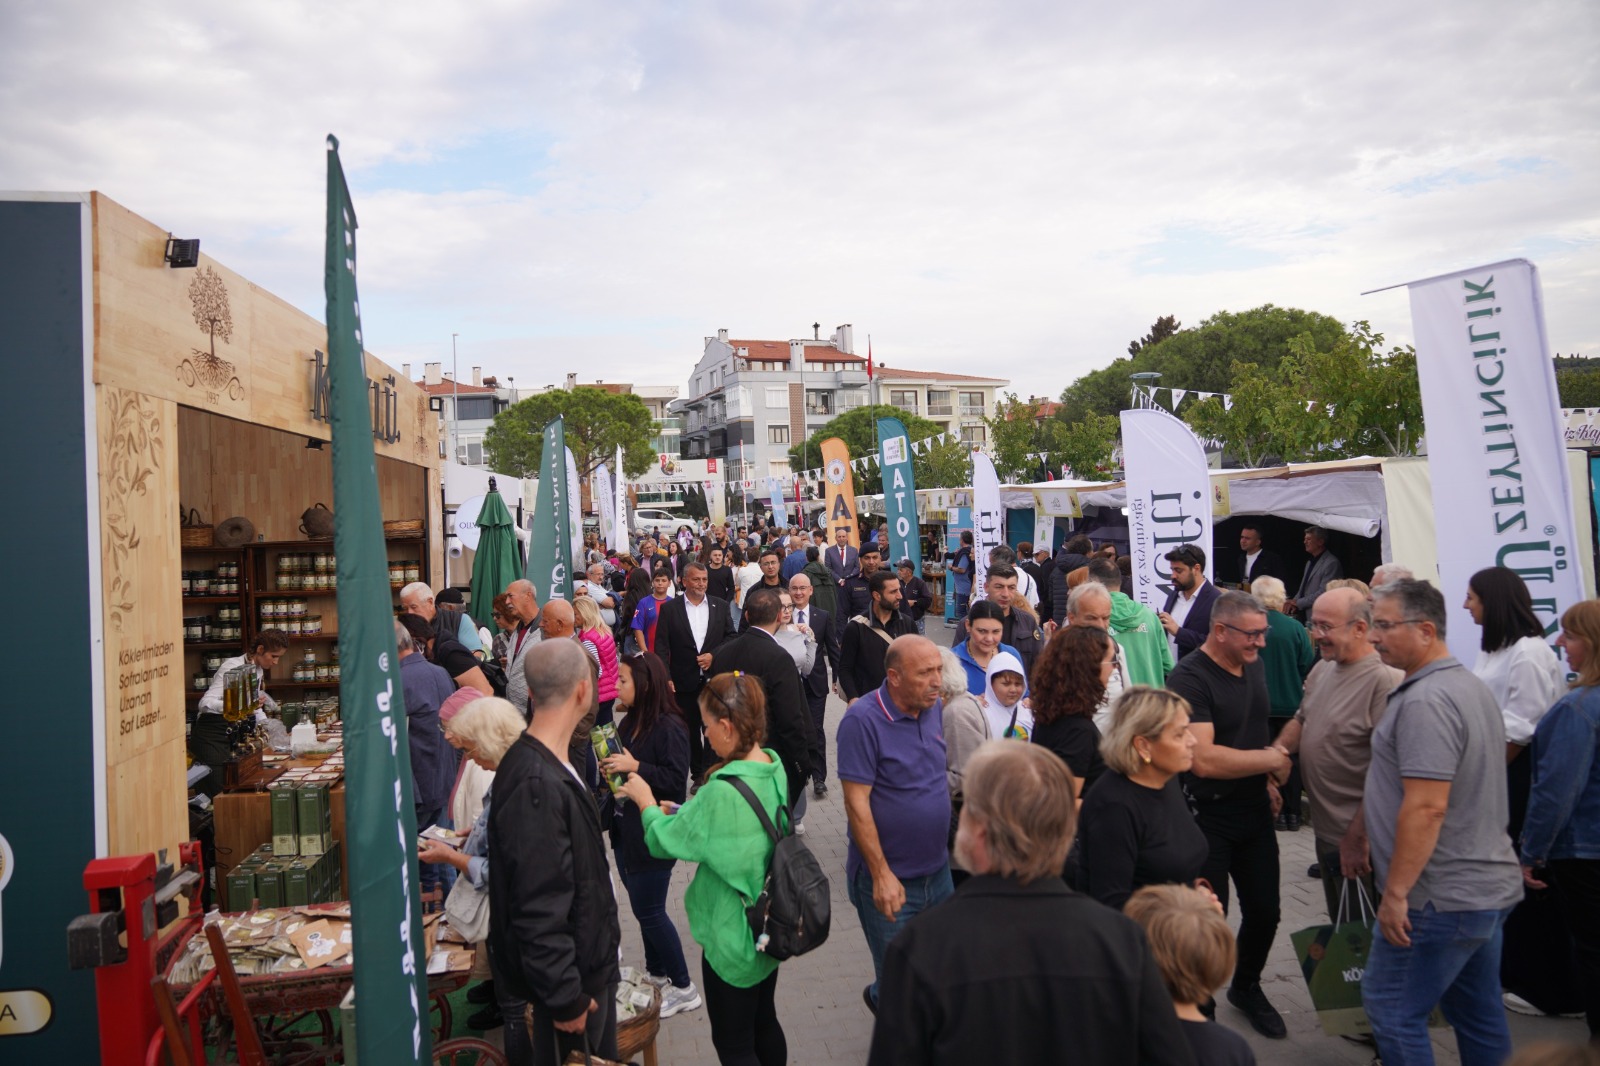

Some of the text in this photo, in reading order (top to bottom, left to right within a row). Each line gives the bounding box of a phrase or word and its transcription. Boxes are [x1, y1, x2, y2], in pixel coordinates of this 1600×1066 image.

[313, 349, 397, 444] KLÜ
[1564, 427, 1575, 439] iz
[619, 480, 627, 526] AYVALIK
[119, 641, 174, 667] Köklerimizden
[119, 691, 152, 713] Uzanan
[119, 715, 134, 736] Saf
[1342, 967, 1366, 982] KÖ
